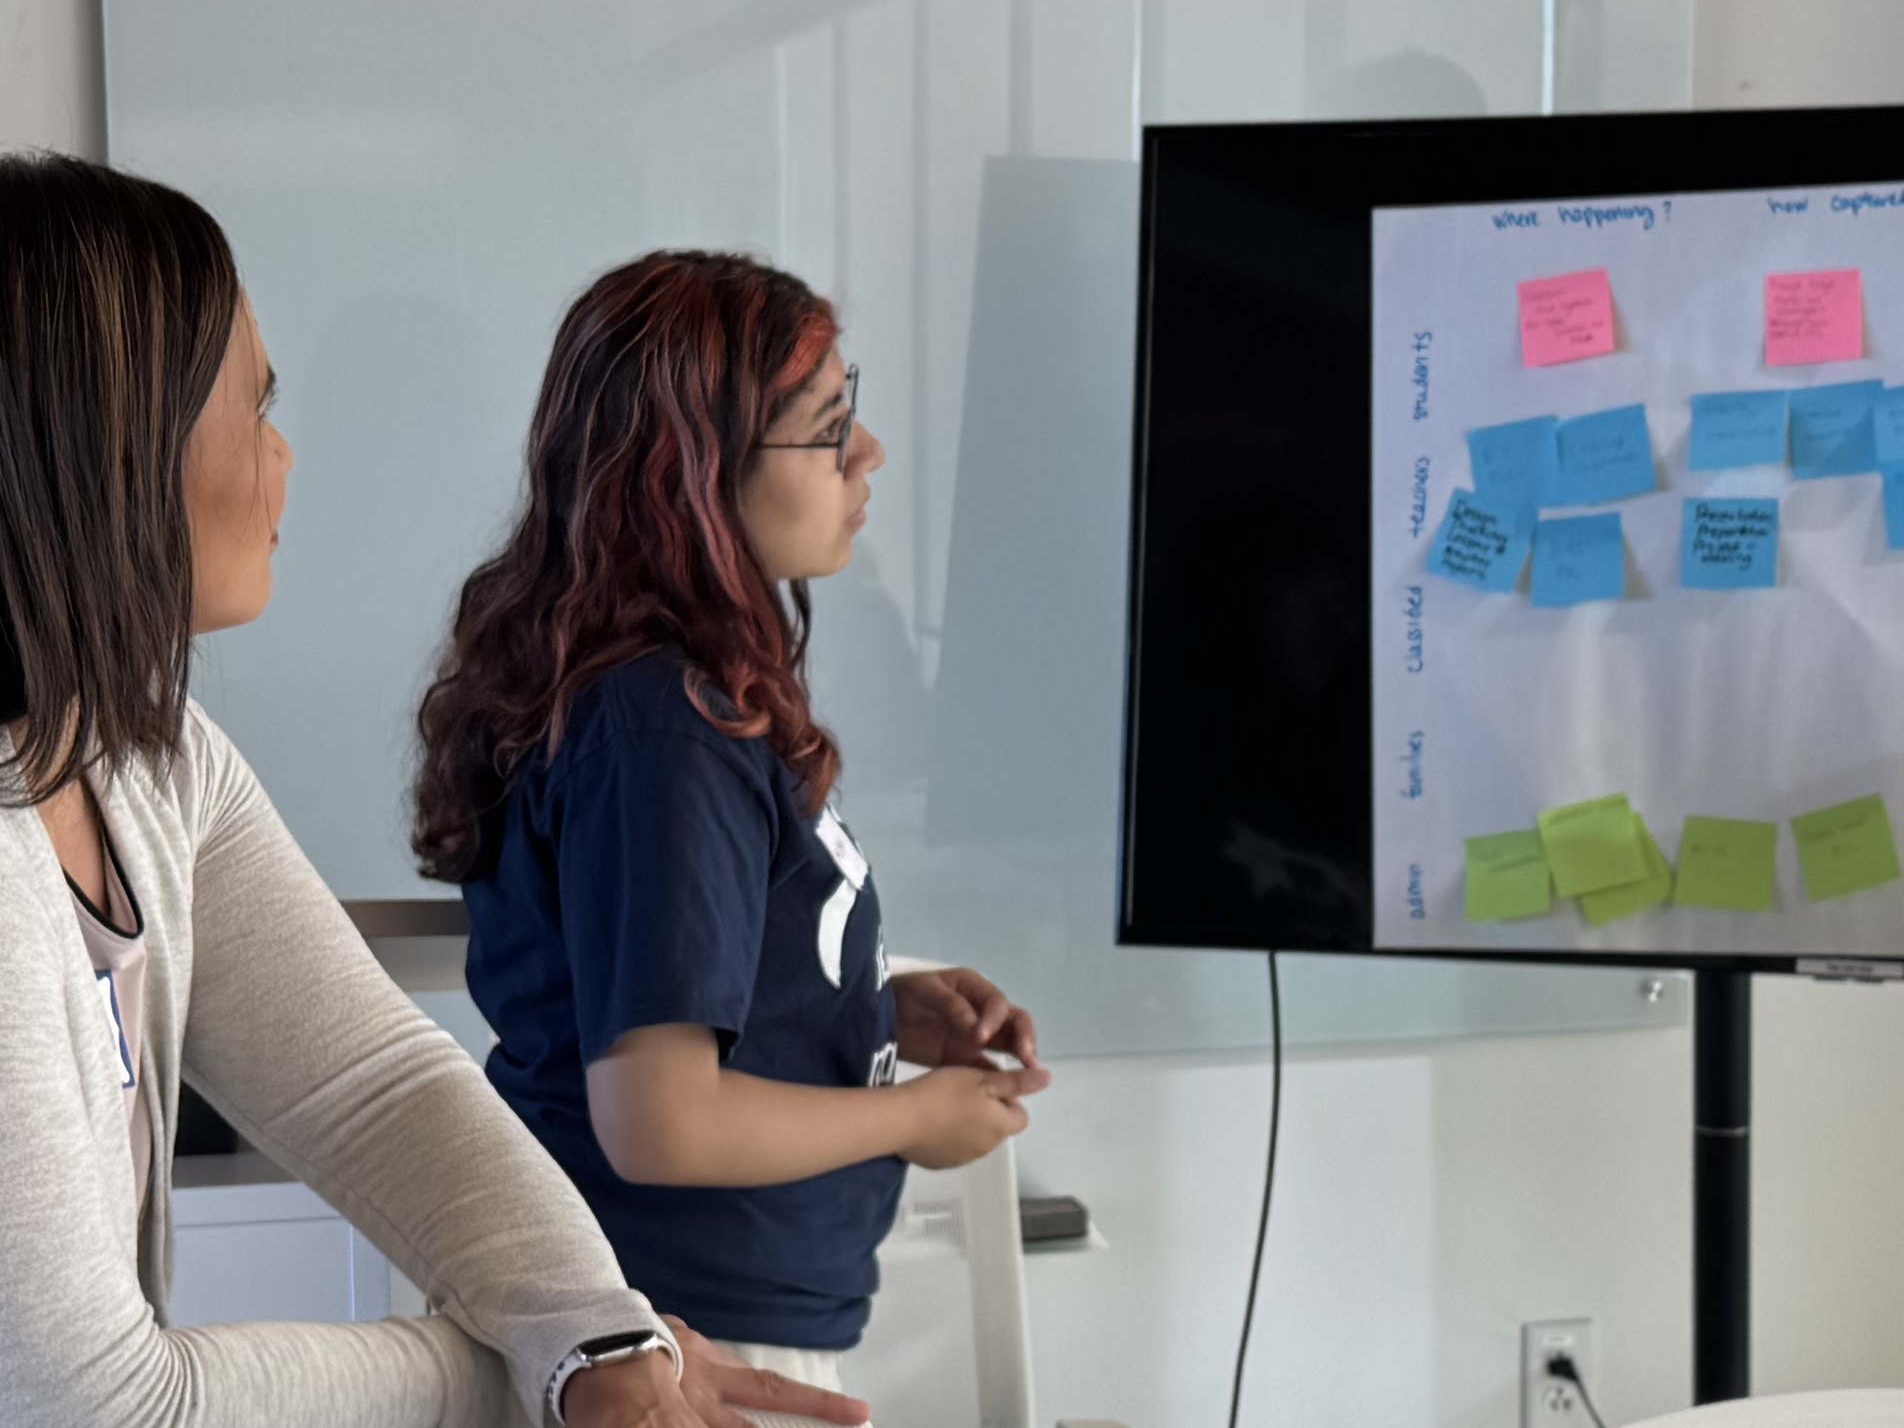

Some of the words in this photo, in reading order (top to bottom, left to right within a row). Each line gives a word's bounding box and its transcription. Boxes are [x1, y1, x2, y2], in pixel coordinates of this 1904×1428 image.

[1491, 209, 1539, 231] where
[1768, 196, 1808, 214] how
[1412, 331, 1433, 422] students
[1409, 456, 1431, 538] teachers
